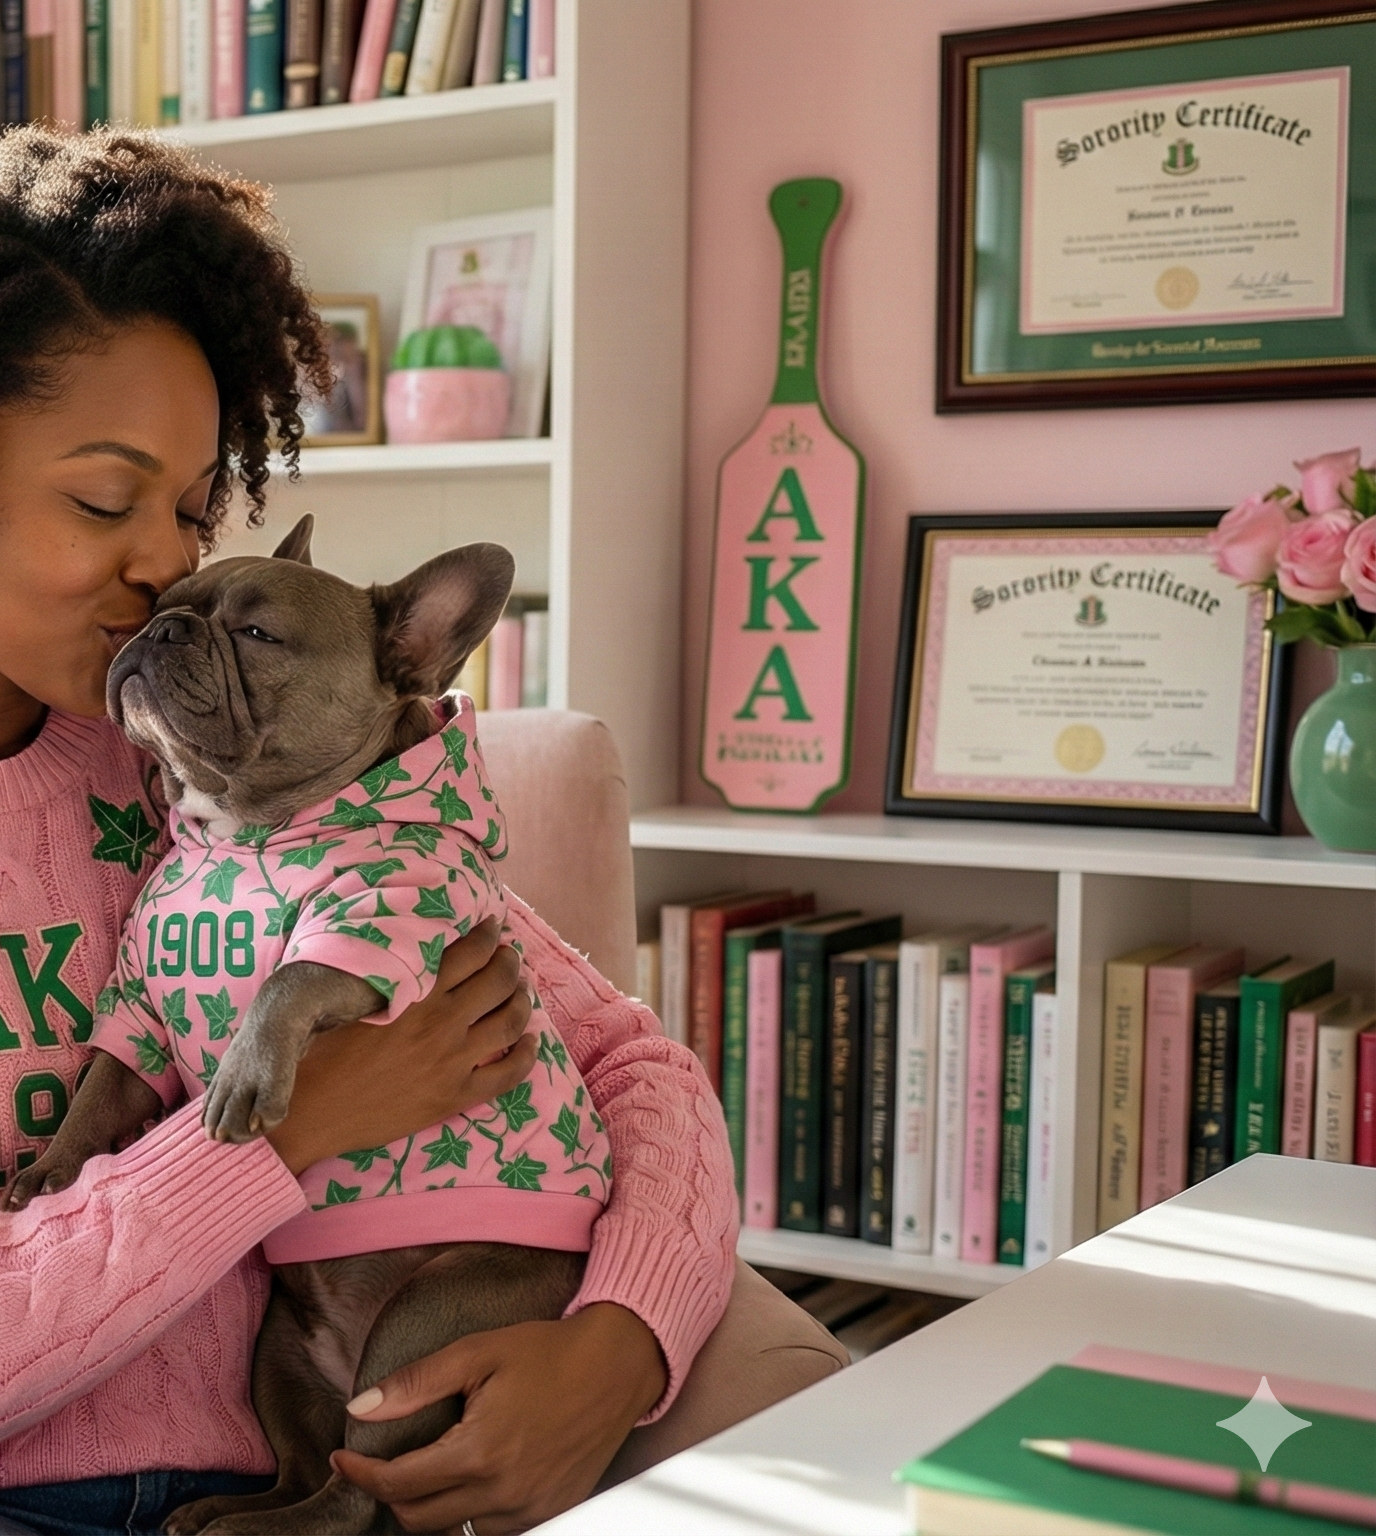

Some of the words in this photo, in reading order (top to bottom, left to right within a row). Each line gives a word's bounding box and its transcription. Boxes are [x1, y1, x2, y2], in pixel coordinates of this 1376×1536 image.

[1056, 107, 1166, 167] Sorority
[1176, 101, 1313, 146] Certificate
[972, 564, 1082, 615] Sorority
[1089, 562, 1222, 616] Certificate
[146, 909, 256, 978] 1908
